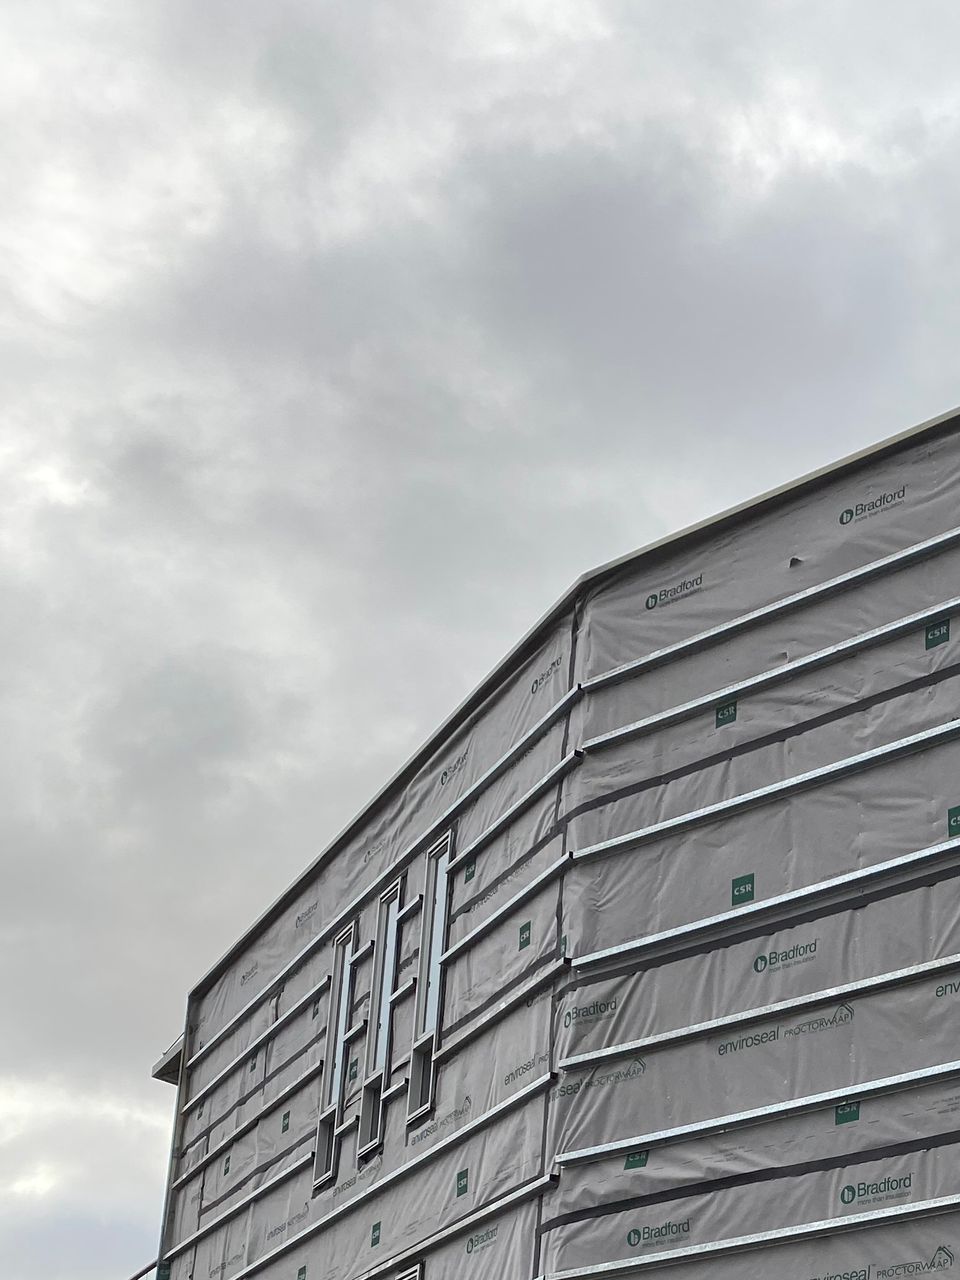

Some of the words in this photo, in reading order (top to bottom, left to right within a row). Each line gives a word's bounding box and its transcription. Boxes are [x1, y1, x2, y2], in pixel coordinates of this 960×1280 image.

[855, 487, 905, 517] Bradford
[659, 574, 703, 601] Bradford
[928, 625, 948, 639] CSR
[718, 706, 735, 720] CSR
[734, 883, 752, 896] CSR
[769, 941, 817, 968] Bradford
[571, 997, 617, 1021] Bradford
[718, 1028, 779, 1056] enviroseal
[783, 1012, 850, 1037] PROCTORWRAP
[857, 1176, 912, 1198] Bradford
[642, 1220, 690, 1240] Bradford
[876, 1258, 949, 1280] PROCTORWRAP
